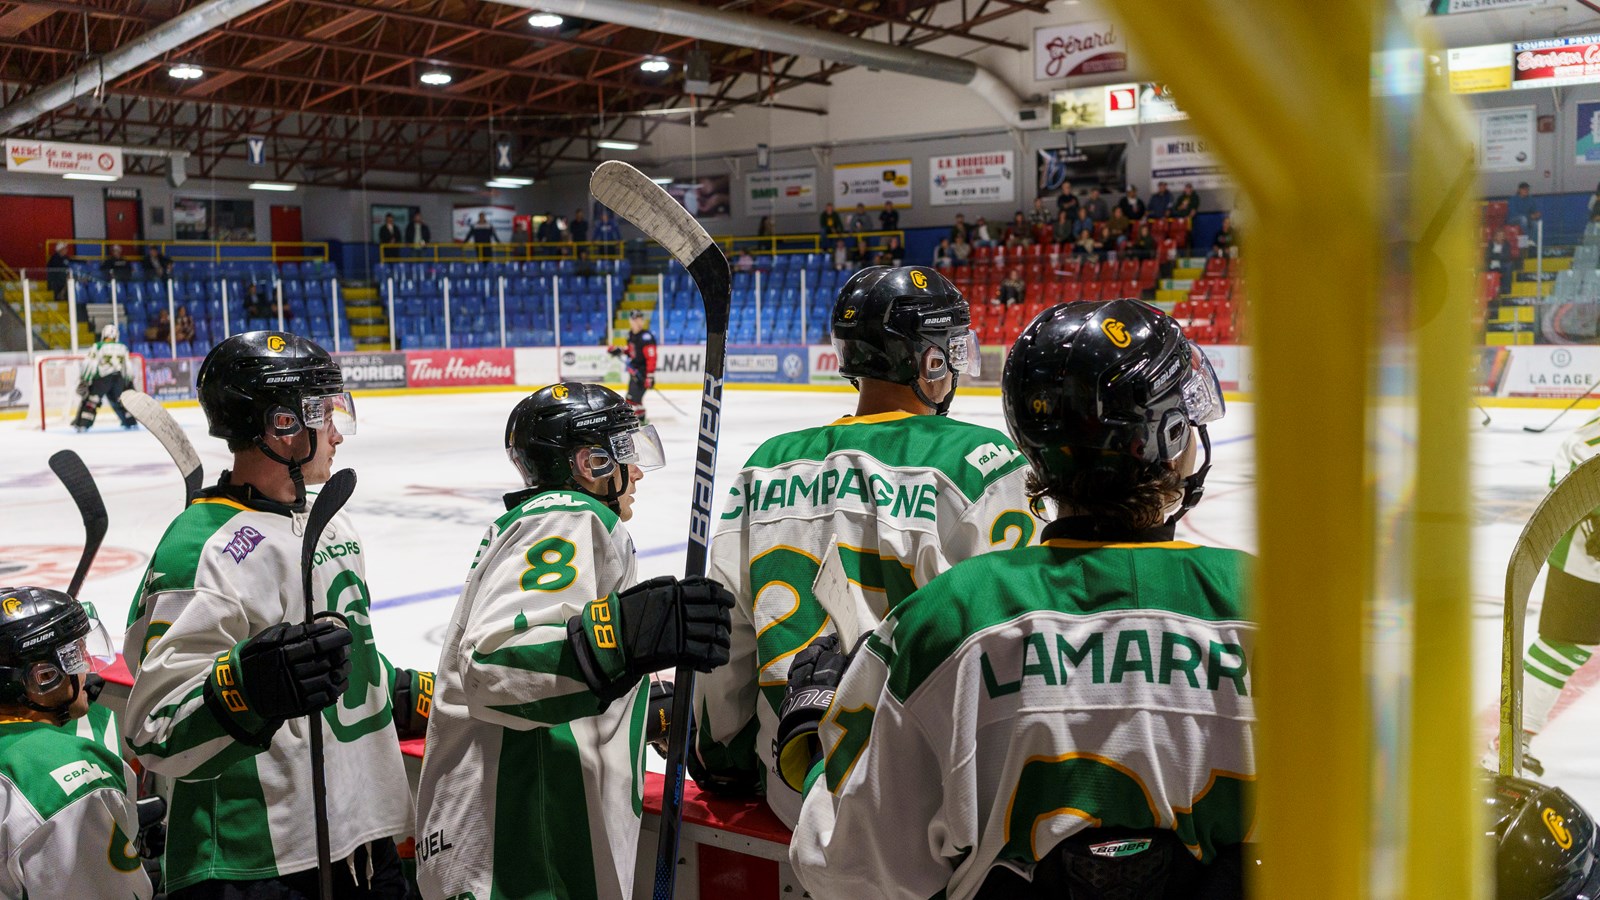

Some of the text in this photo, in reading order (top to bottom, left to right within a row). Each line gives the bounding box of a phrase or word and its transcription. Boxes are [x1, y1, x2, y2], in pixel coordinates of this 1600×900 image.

[1045, 24, 1117, 76] Gérard
[1516, 34, 1600, 51] TOURNOI PROV
[249, 140, 264, 164] Y
[498, 144, 510, 167] X
[844, 310, 855, 319] 27
[924, 316, 952, 325] BAUER
[343, 365, 405, 382] POIRIER
[410, 357, 512, 381] Tim Hortons
[1152, 360, 1181, 390] BAUER
[265, 375, 301, 384] BAUER
[1529, 373, 1593, 385] LA CAGE
[1033, 399, 1047, 414] 91
[575, 415, 608, 427] BAUER
[690, 371, 723, 548] BAUER
[720, 468, 939, 522] CHAMPAGNE
[519, 536, 579, 593] 8
[22, 631, 55, 648] BAUER
[63, 767, 90, 783] CBA
[673, 763, 683, 806] NEXUS
[1096, 842, 1146, 854] BAUER
